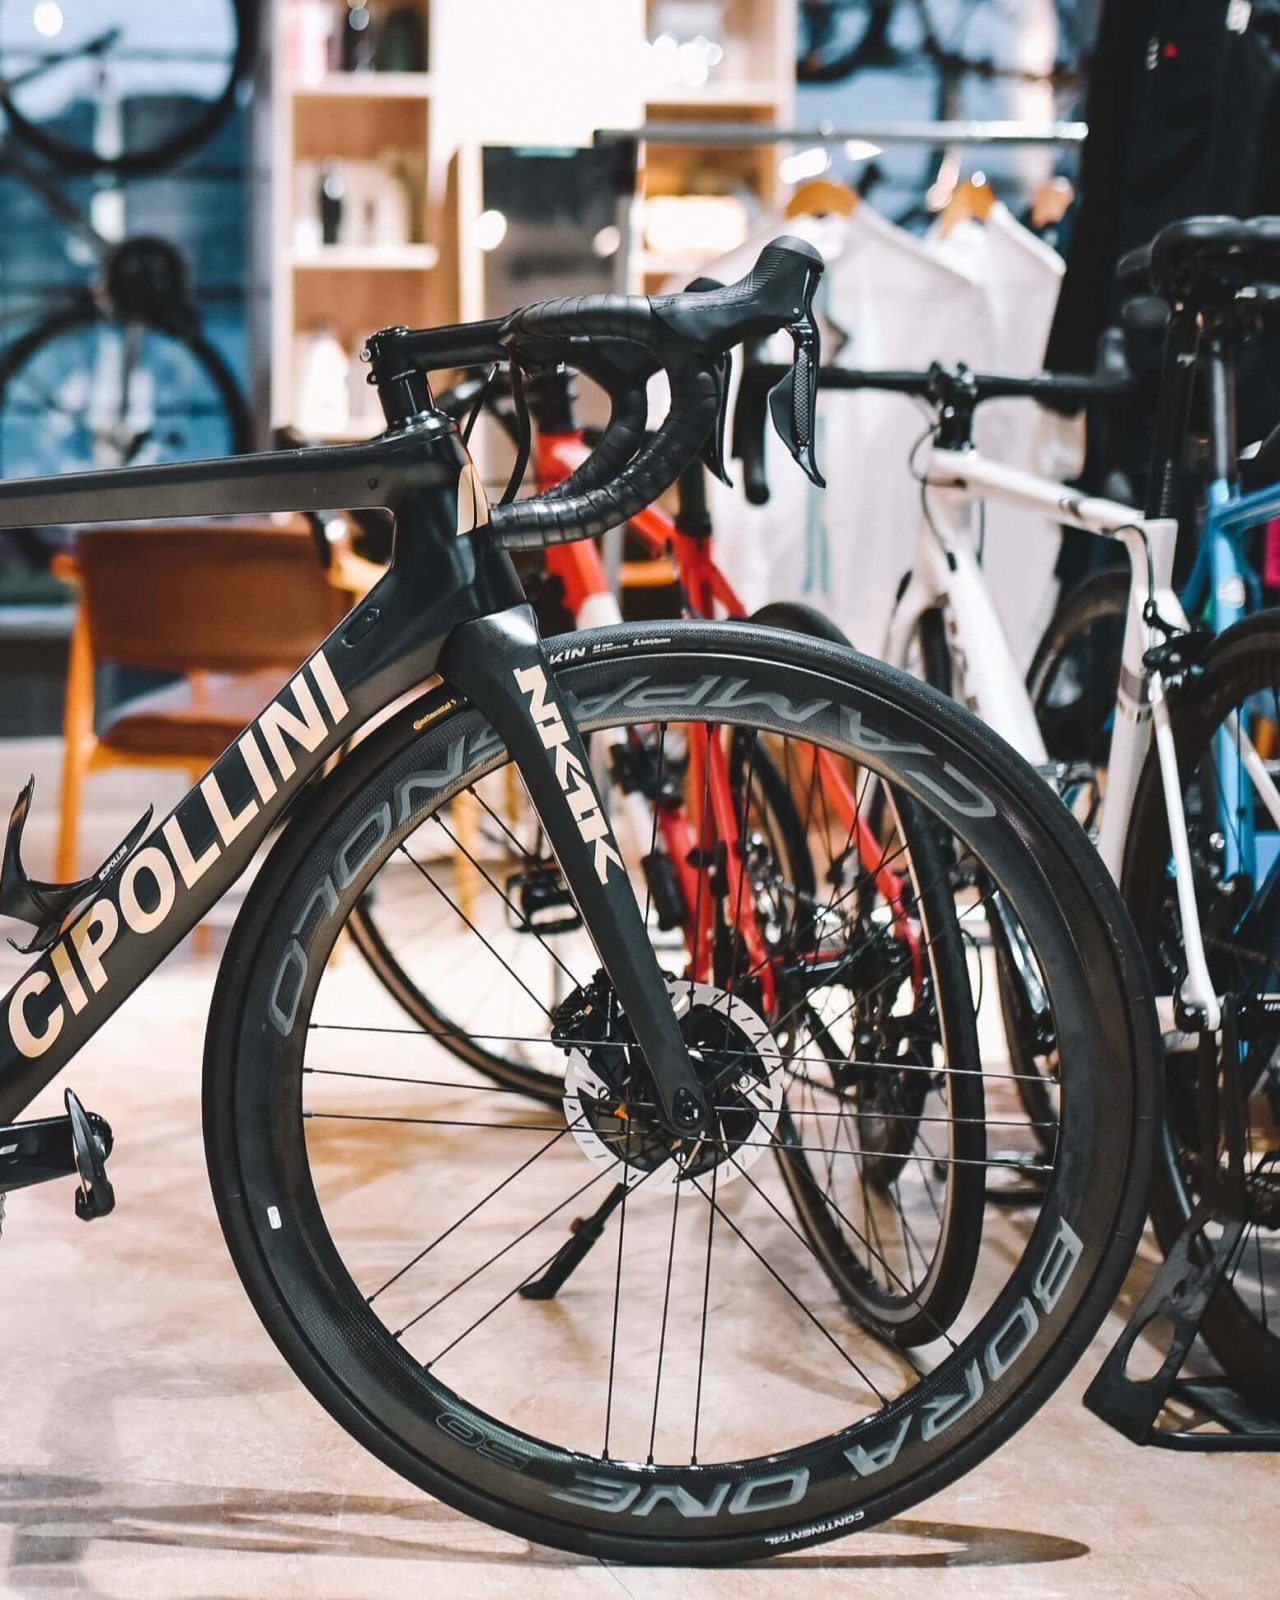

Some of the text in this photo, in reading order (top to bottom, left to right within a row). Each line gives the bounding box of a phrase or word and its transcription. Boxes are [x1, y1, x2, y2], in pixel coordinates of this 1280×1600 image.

[548, 646, 587, 665] KIN
[7, 649, 350, 1059] CIPOLLINI
[842, 1215, 1085, 1478] BORA
[549, 1467, 810, 1519] ONE
[764, 1510, 865, 1545] CONTINENTAL
